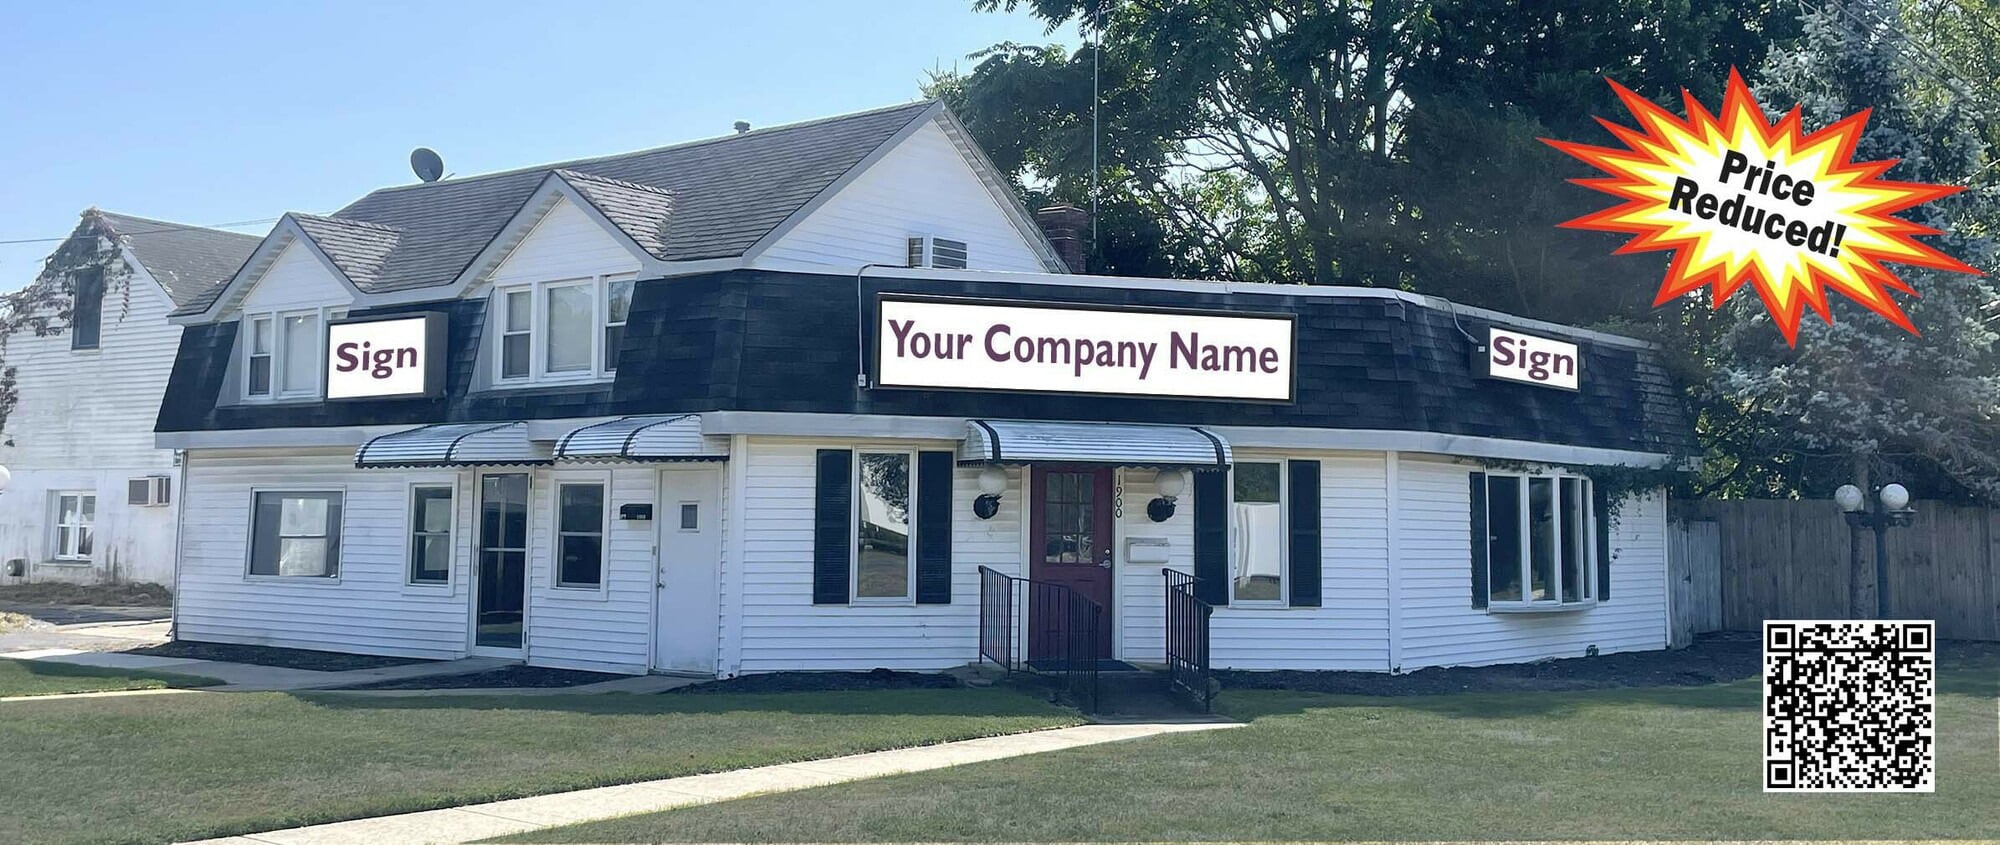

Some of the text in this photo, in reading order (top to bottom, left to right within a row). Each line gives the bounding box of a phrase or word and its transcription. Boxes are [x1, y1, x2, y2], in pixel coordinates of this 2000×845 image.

[336, 341, 418, 379] Sign
[888, 319, 1279, 380] Your Company Name
[1492, 336, 1574, 381] Sign
[1115, 474, 1123, 518] 1900
